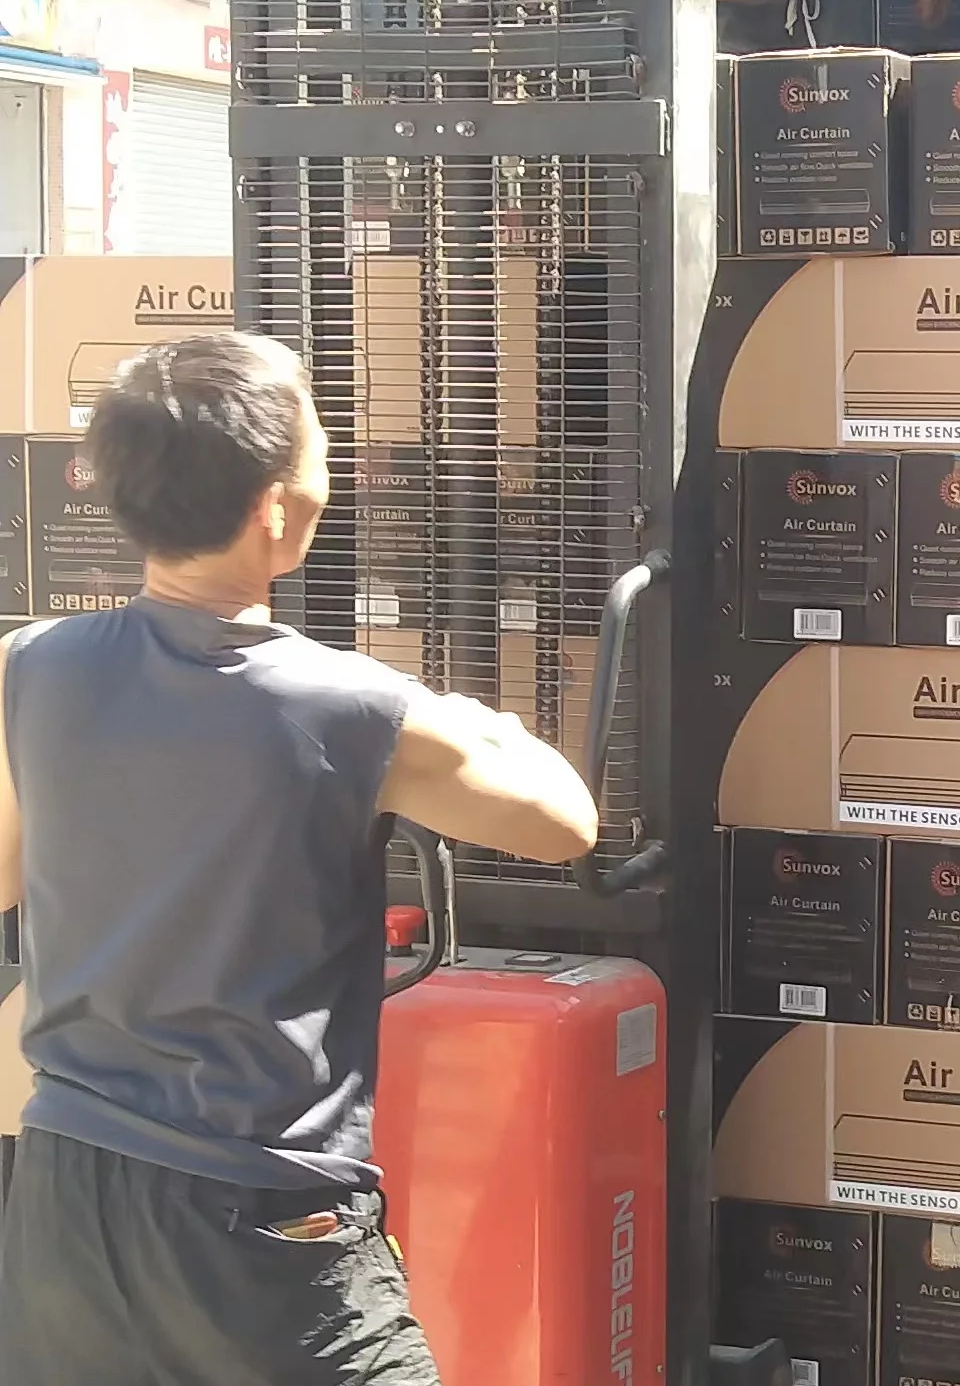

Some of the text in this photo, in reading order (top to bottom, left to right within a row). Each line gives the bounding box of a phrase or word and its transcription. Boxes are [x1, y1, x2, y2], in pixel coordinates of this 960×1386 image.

[788, 86, 850, 104] Sunvox
[777, 126, 851, 141] Air Curtain
[134, 284, 180, 310] Air
[850, 424, 889, 440] WITH
[893, 425, 921, 440] THE
[796, 479, 857, 496] Sunvox
[63, 503, 82, 515] Air
[784, 518, 857, 532] Air Curtain
[936, 521, 958, 536] Air
[846, 805, 887, 822] WITH
[889, 808, 919, 823] THE
[783, 858, 841, 877] Sunvox
[928, 908, 948, 922] Air
[904, 1059, 953, 1089] Air
[837, 1185, 876, 1203] WITH
[880, 1189, 908, 1206] THE
[777, 1232, 833, 1252] Sunvox
[919, 1283, 939, 1297] Air
